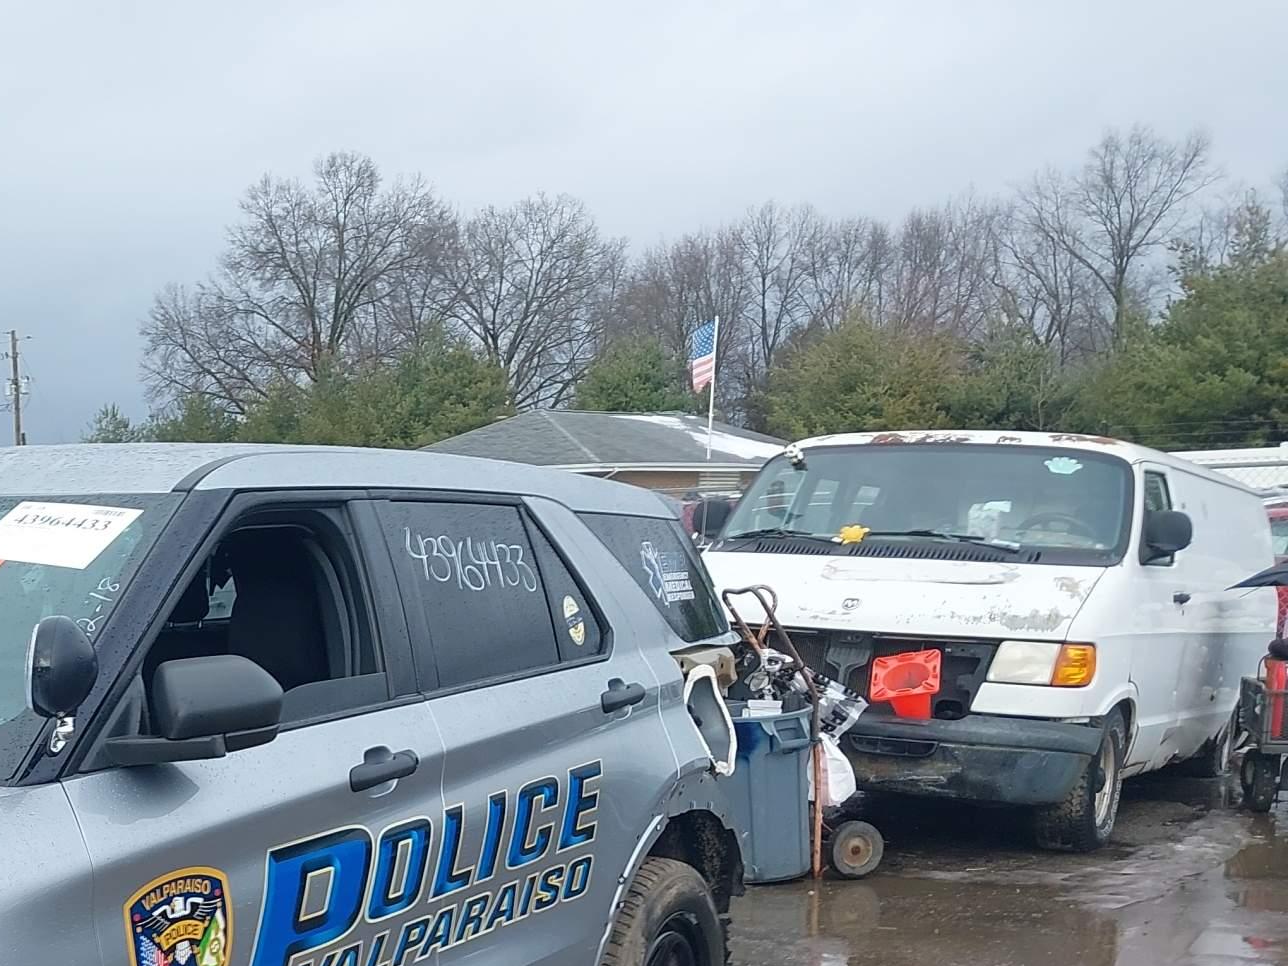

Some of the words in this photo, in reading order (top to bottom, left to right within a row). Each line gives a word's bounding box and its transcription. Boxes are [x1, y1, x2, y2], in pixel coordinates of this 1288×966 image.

[13, 513, 112, 531] 43964433
[404, 527, 537, 592] 43964433
[141, 878, 212, 911] VALPARAISO
[164, 923, 200, 946] POLICE
